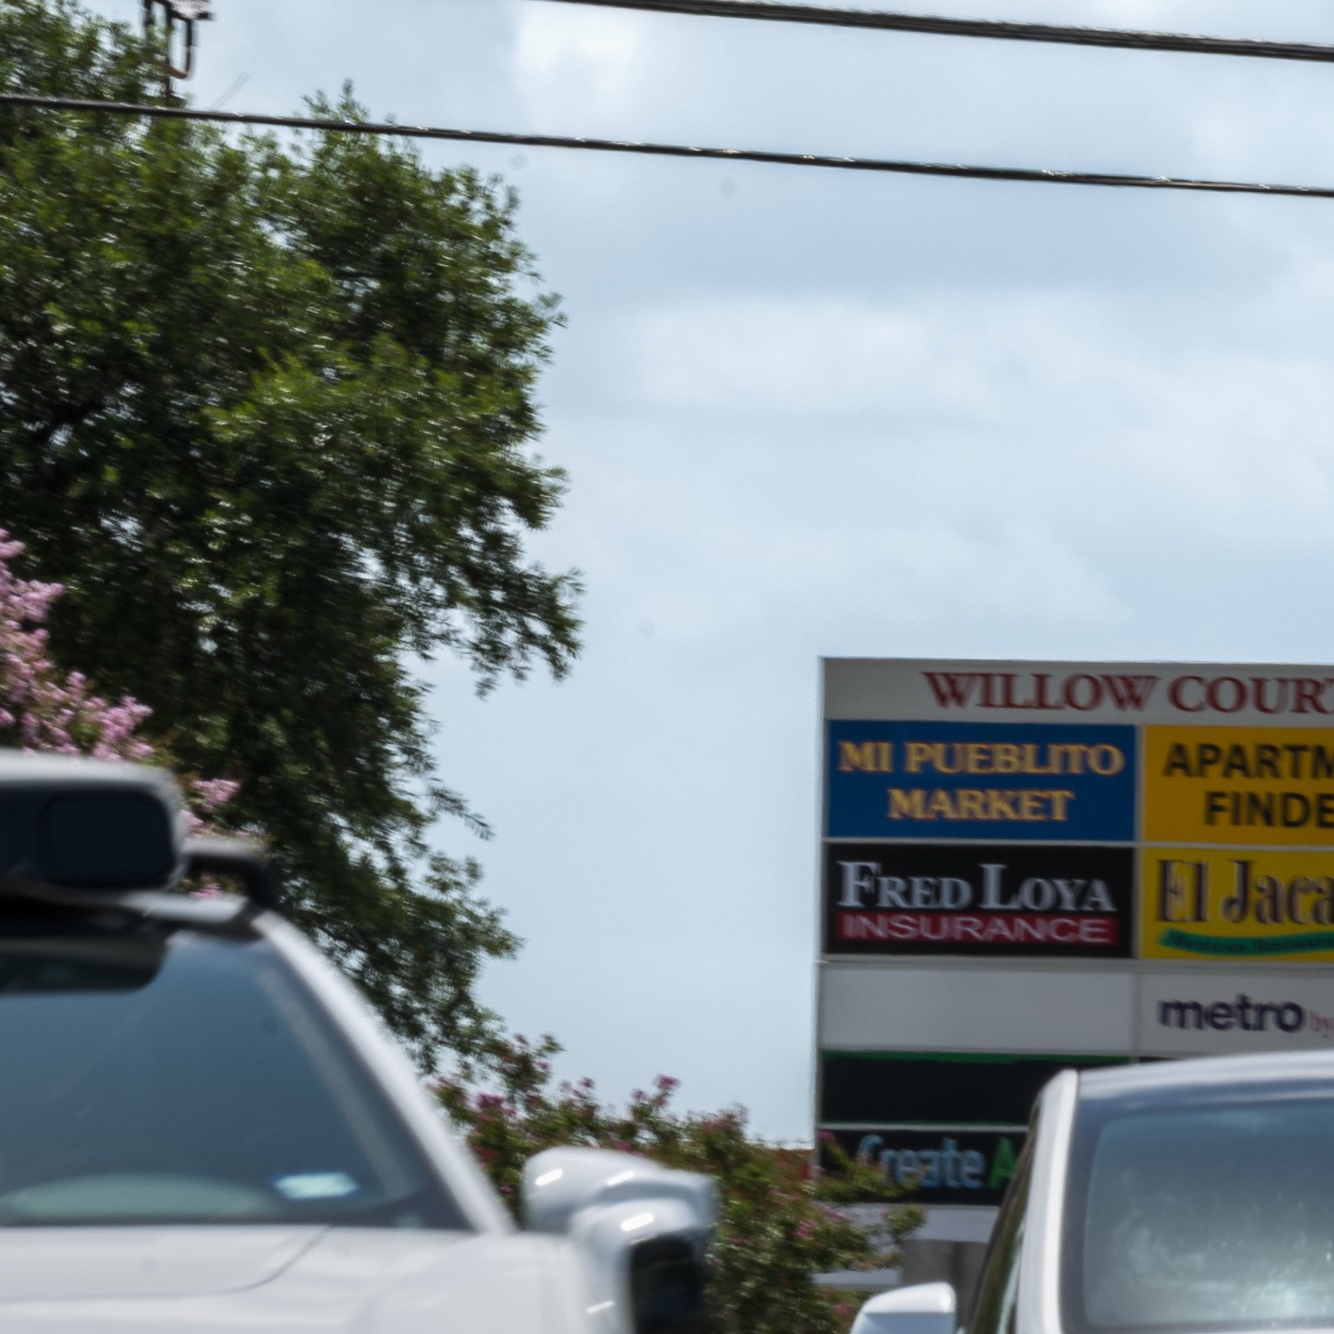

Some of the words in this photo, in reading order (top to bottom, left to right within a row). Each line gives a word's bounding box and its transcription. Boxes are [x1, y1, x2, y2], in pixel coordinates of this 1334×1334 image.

[920, 671, 1163, 713] WILLOW
[837, 741, 895, 773] MI
[903, 742, 1126, 776] PUEBLITO
[887, 787, 1076, 822] MARKET
[1156, 858, 1211, 924] El
[842, 913, 1113, 944] INSURANCE
[1158, 993, 1305, 1034] metro
